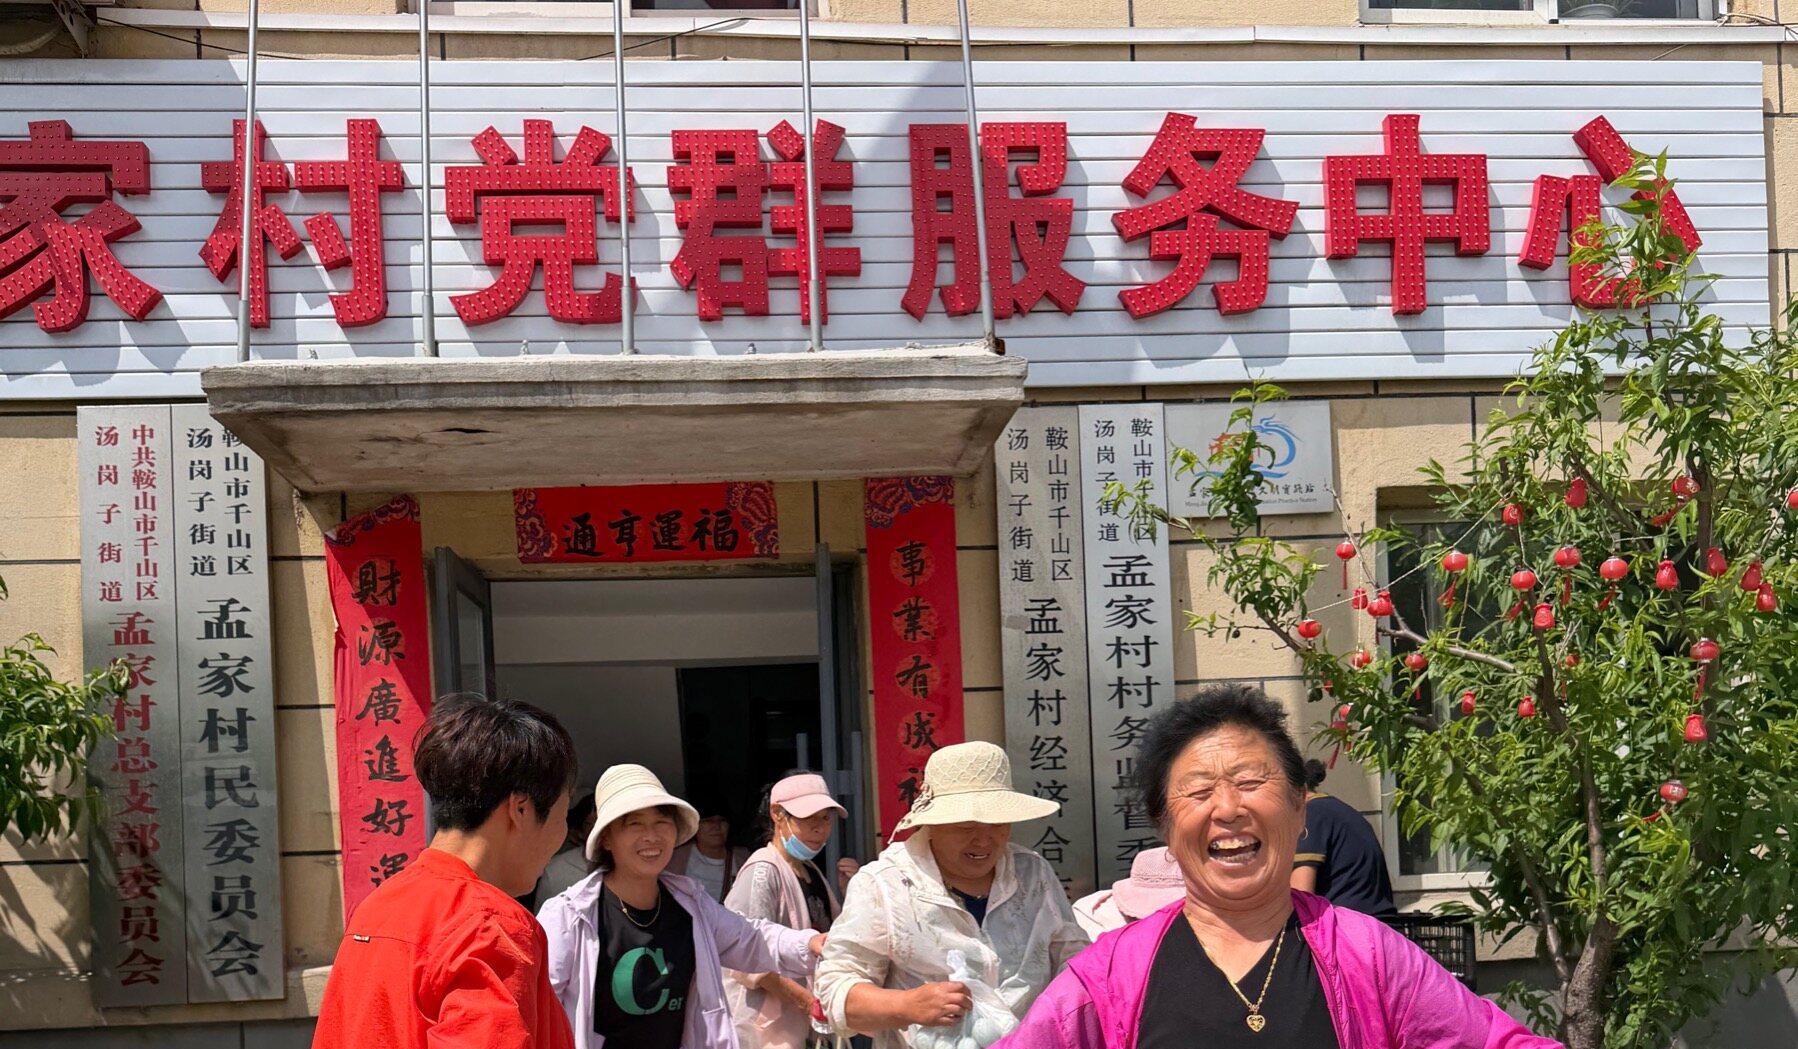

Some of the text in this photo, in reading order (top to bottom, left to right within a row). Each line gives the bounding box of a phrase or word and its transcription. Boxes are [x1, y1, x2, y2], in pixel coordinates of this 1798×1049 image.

[0, 113, 1703, 332] 家村党群服务中心
[95, 425, 123, 602] 汤岗子街道
[131, 424, 159, 601] 中共鞍山市千山区
[187, 427, 217, 576] 汤岗子街道
[1007, 428, 1035, 582] 汤岗子街道
[1045, 426, 1073, 582] 鞍山市千山区
[196, 597, 264, 978] 孟家村民委员会
[1024, 597, 1073, 900] 孟家村经济合
